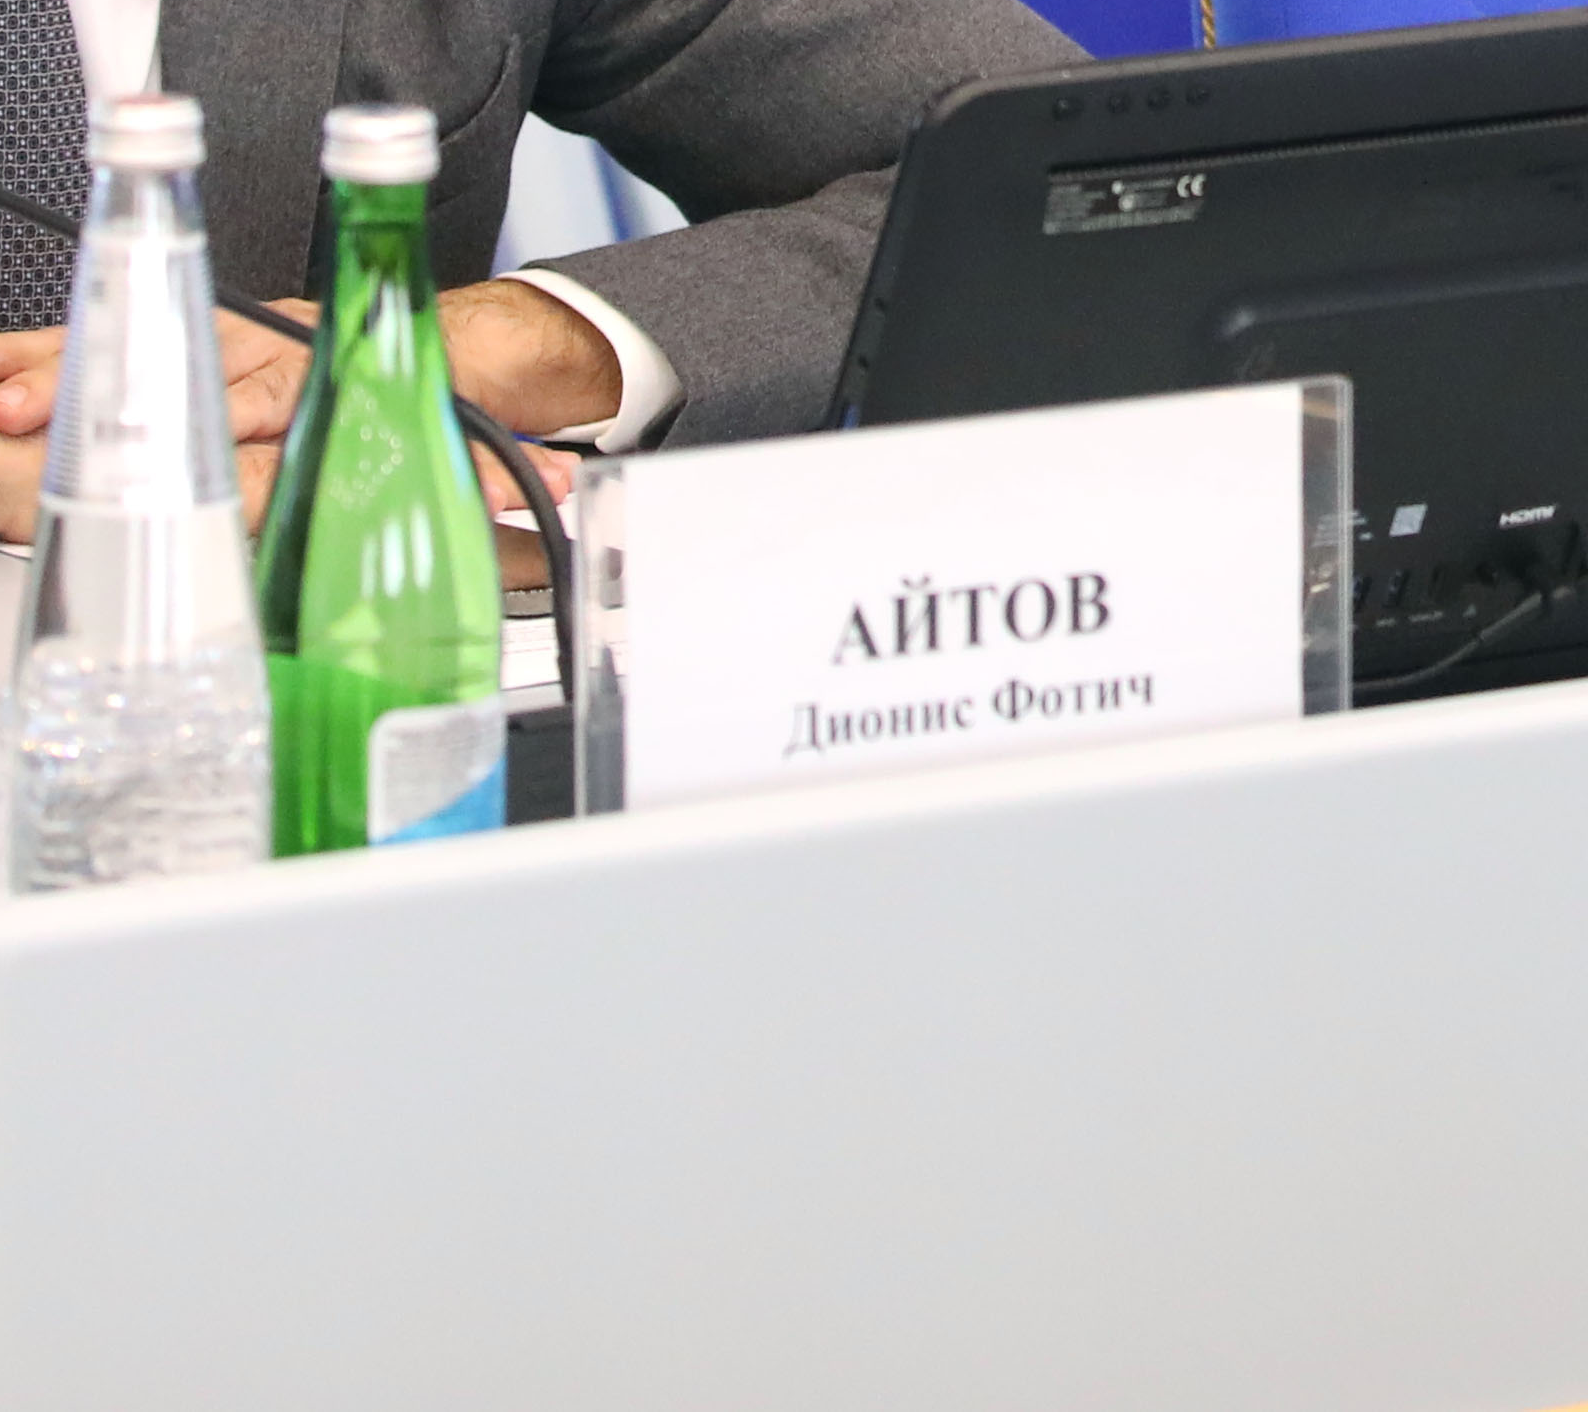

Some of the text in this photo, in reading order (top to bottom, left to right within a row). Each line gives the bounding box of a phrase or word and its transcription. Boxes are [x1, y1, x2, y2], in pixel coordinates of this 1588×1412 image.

[831, 572, 1110, 665] АЙТОВ
[782, 674, 1155, 758] Дионис Фотич
